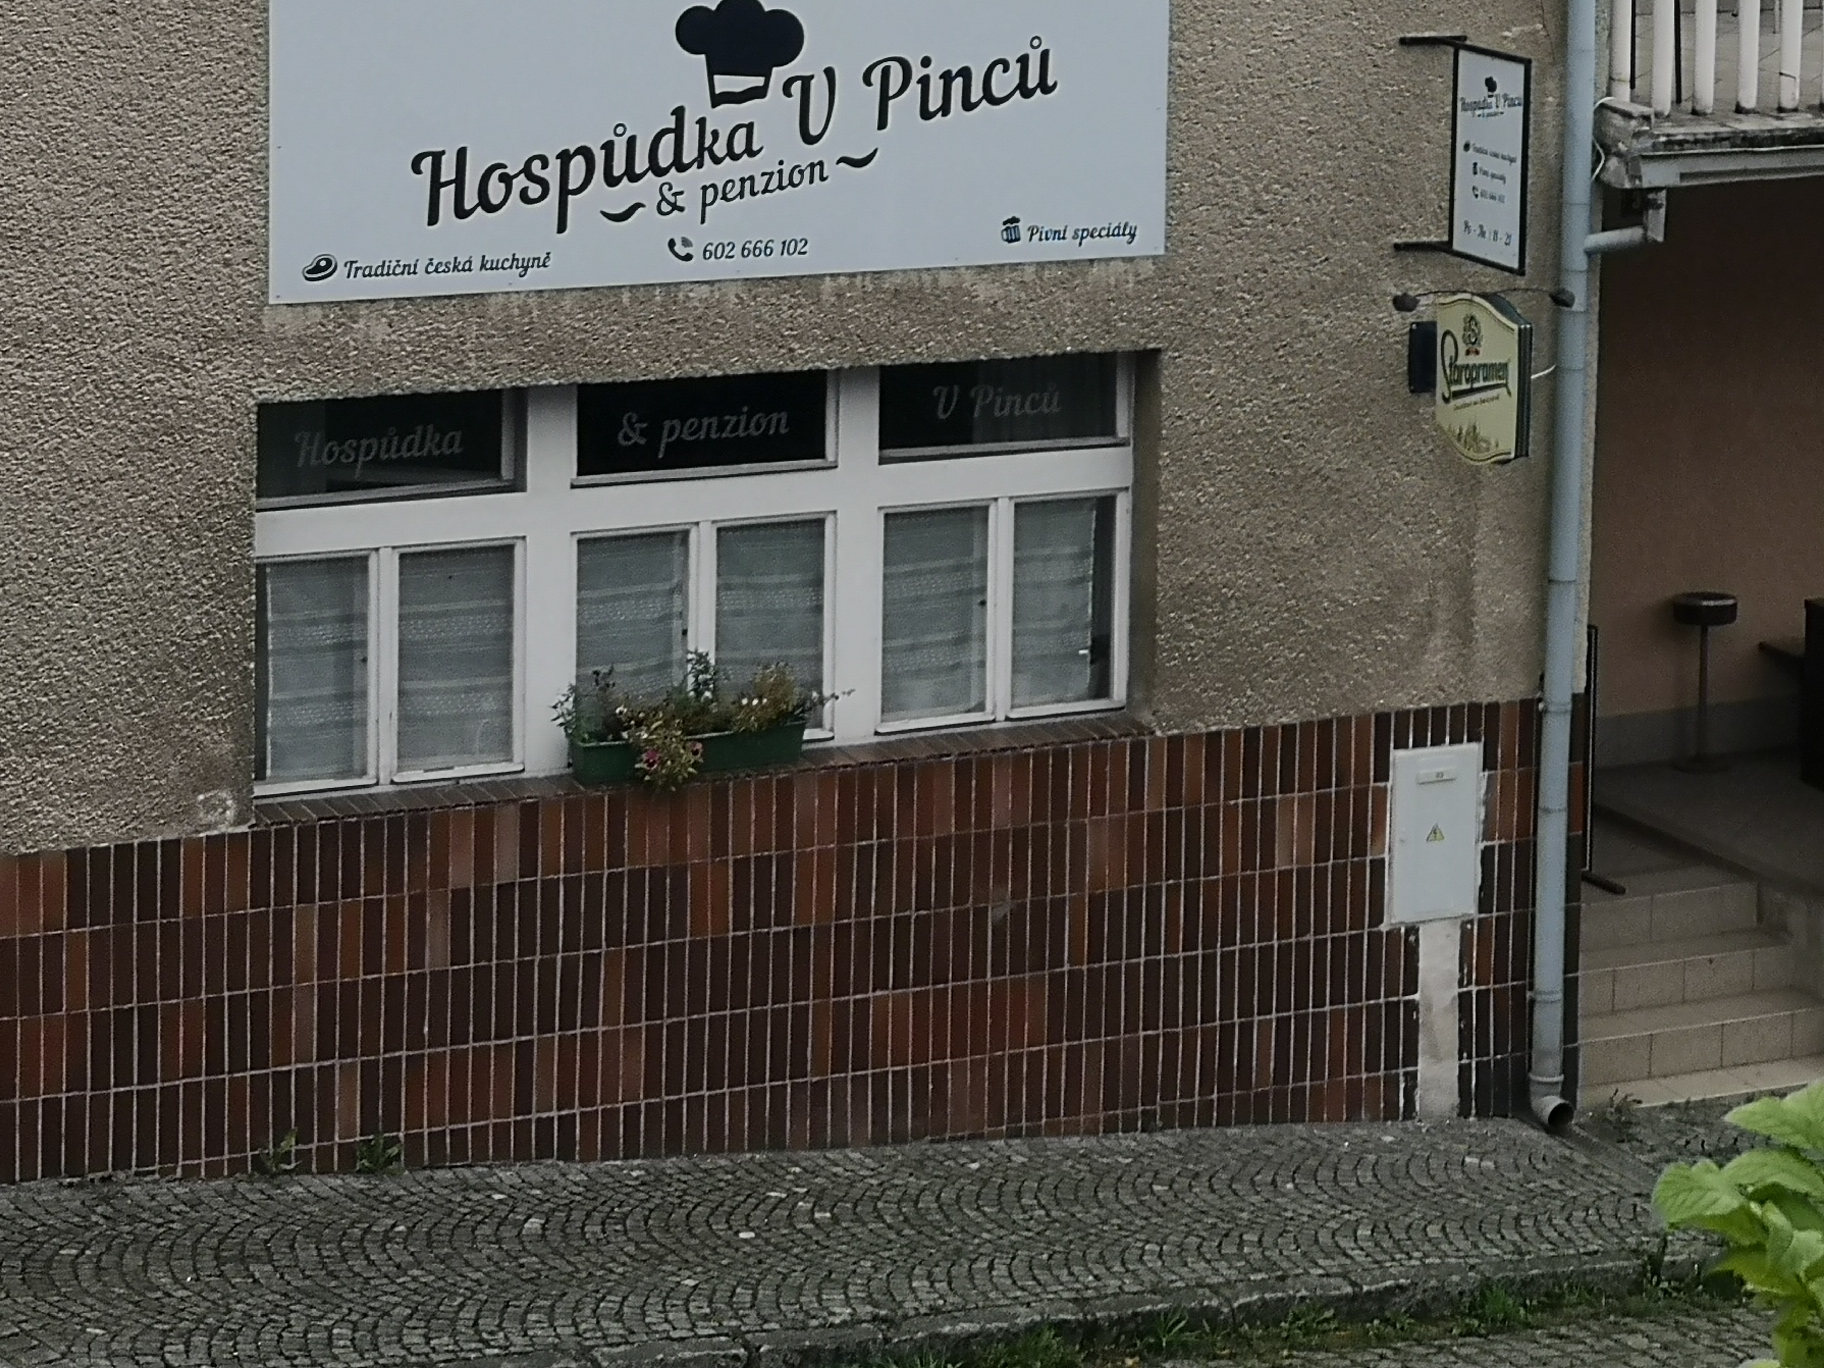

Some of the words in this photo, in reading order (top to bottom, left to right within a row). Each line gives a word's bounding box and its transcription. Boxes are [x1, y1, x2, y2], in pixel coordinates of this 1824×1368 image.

[411, 105, 764, 234] Hospůdka
[781, 67, 838, 145] V
[862, 36, 1058, 130] Pinců
[656, 182, 685, 216] &
[700, 160, 829, 224] penzion
[702, 242, 735, 260] 602
[741, 239, 773, 257] 666
[780, 238, 808, 256] 102
[1027, 224, 1068, 242] Pivní
[1072, 221, 1137, 247] speciály
[344, 259, 419, 279] Tradiční
[424, 256, 473, 275] česká
[479, 251, 551, 277] kuchyně
[1441, 330, 1512, 404] Staropramen
[932, 386, 961, 421] V
[970, 381, 1062, 420] Pinců
[294, 422, 463, 468] Hospůdka
[617, 412, 648, 446] &
[659, 406, 790, 458] penzion
